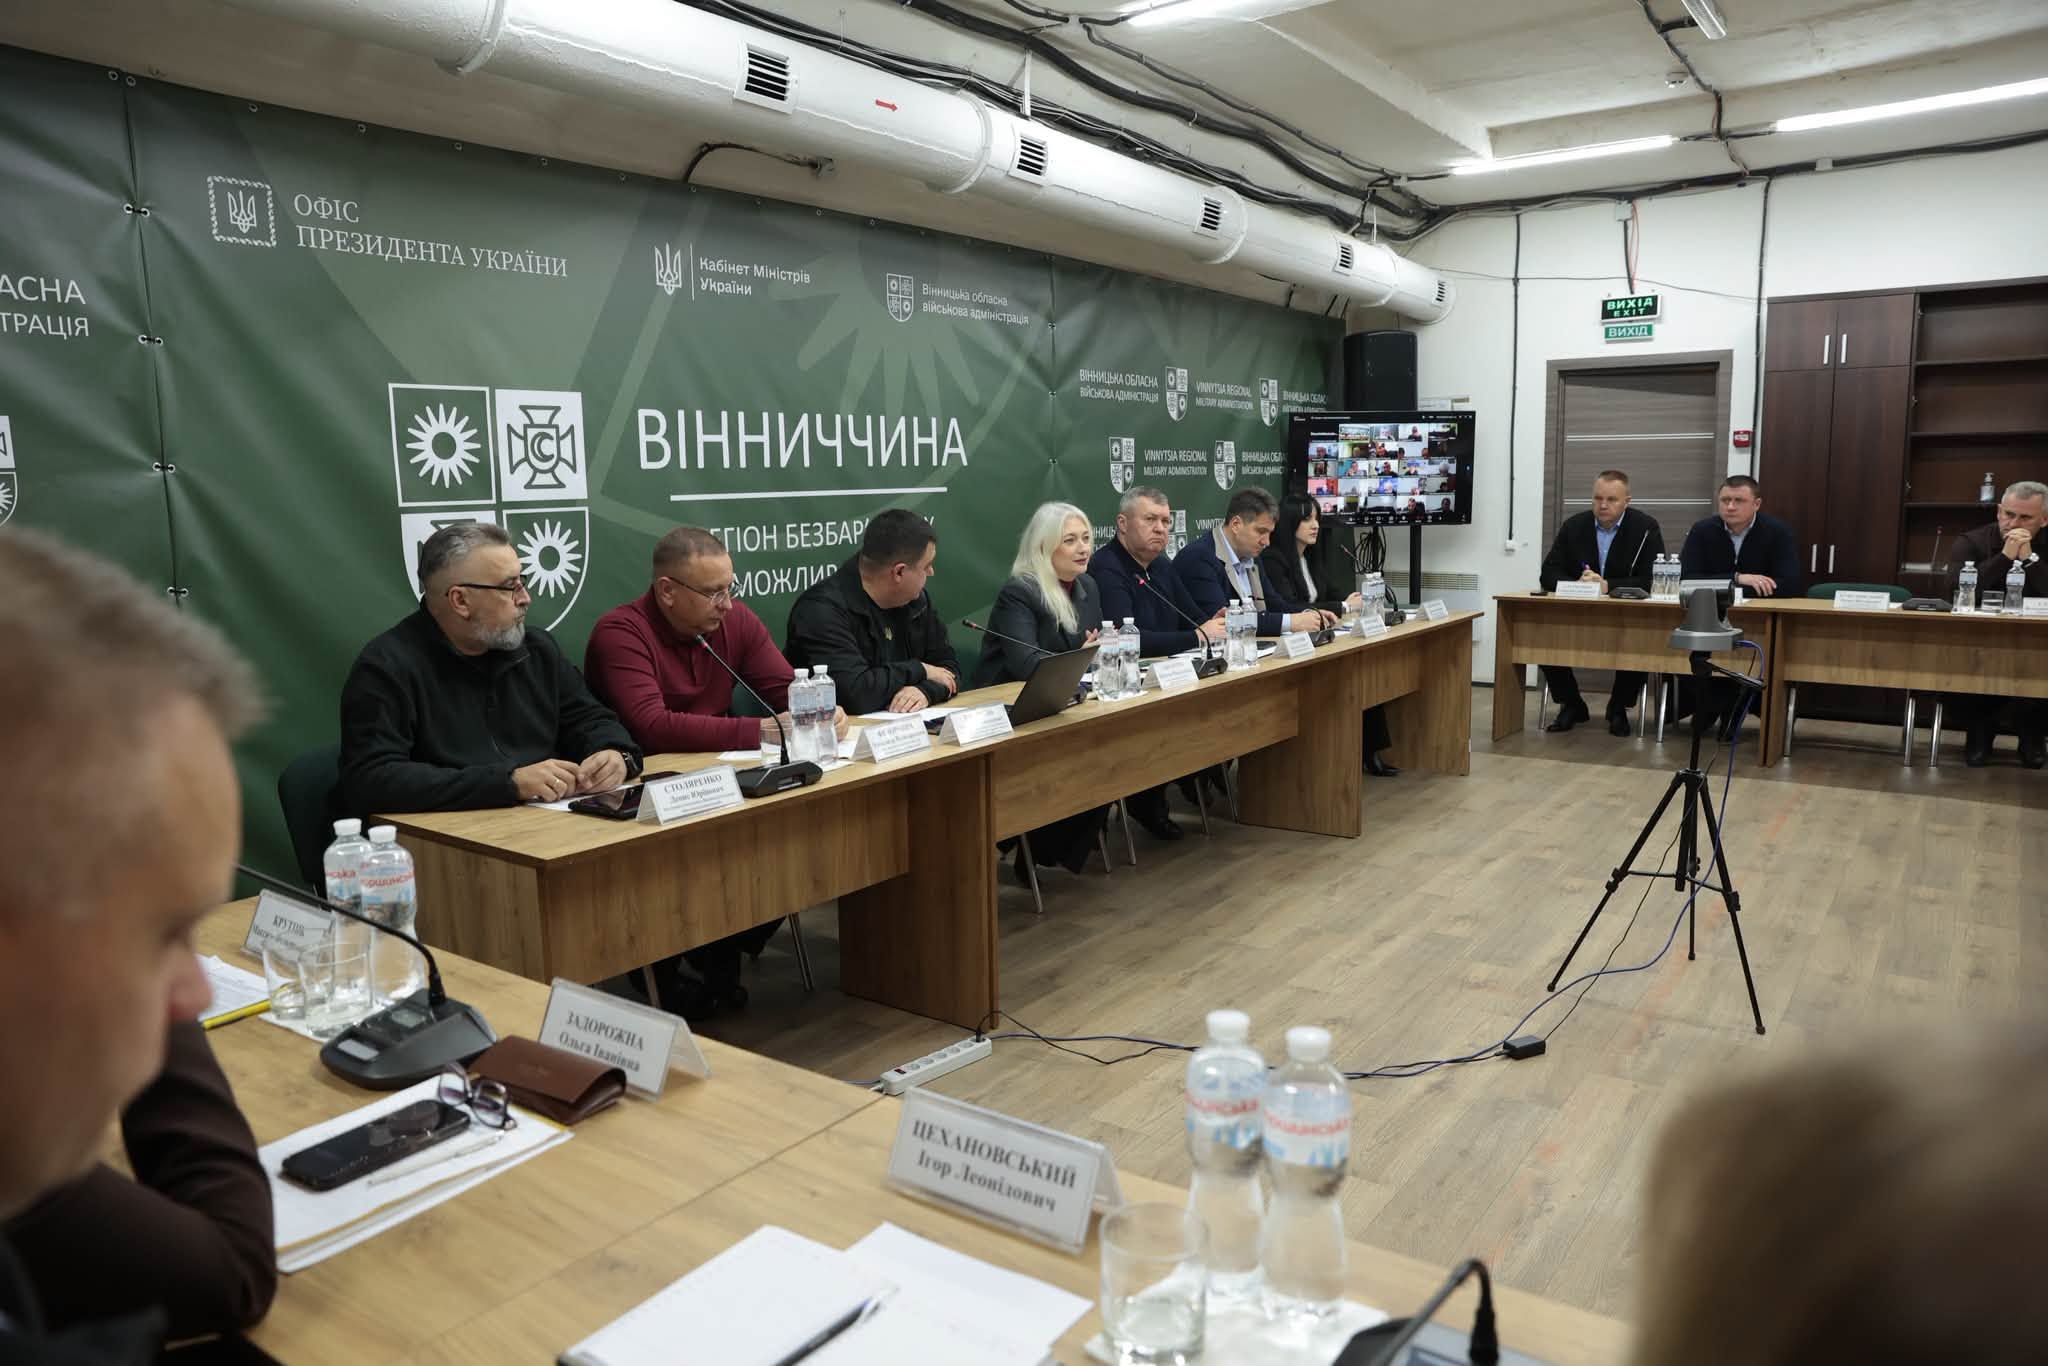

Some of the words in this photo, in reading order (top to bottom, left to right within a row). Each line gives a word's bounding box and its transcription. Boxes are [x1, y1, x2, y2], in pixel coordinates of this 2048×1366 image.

[293, 193, 359, 223] ОФІС
[295, 225, 466, 266] ПРЕЗИДЕНТА
[470, 247, 568, 277] УКРАЇНИ
[699, 256, 751, 276] Кабінет
[753, 263, 811, 286] Міністрів
[699, 277, 752, 296] України
[922, 283, 970, 301] Вінницька
[971, 291, 1008, 306] обласна
[922, 301, 968, 317] військова
[970, 307, 1029, 325] адміністрація
[1606, 297, 1653, 310] ВИХІД
[1613, 308, 1646, 317] EXIT
[1607, 325, 1649, 337] ВИХІД
[1079, 369, 1124, 386] ВІННИЦЬКА
[1124, 373, 1159, 388] ОБЛАСНА
[637, 408, 969, 470] ВІННИЧЧИНА
[1144, 449, 1178, 462] VINNYTSIA
[1179, 449, 1208, 462] REGIONAL
[664, 775, 722, 793] СТОЛЯРЕНКО
[567, 1010, 644, 1051] ЗАДОРОЖНА
[559, 1031, 592, 1054] Ольга
[593, 1042, 641, 1073] Іванівна
[912, 1119, 1077, 1189] ЦЕХАНОВСЬКИЙ
[917, 1148, 952, 1180] Ігор
[954, 1161, 1057, 1213] Леонідович
